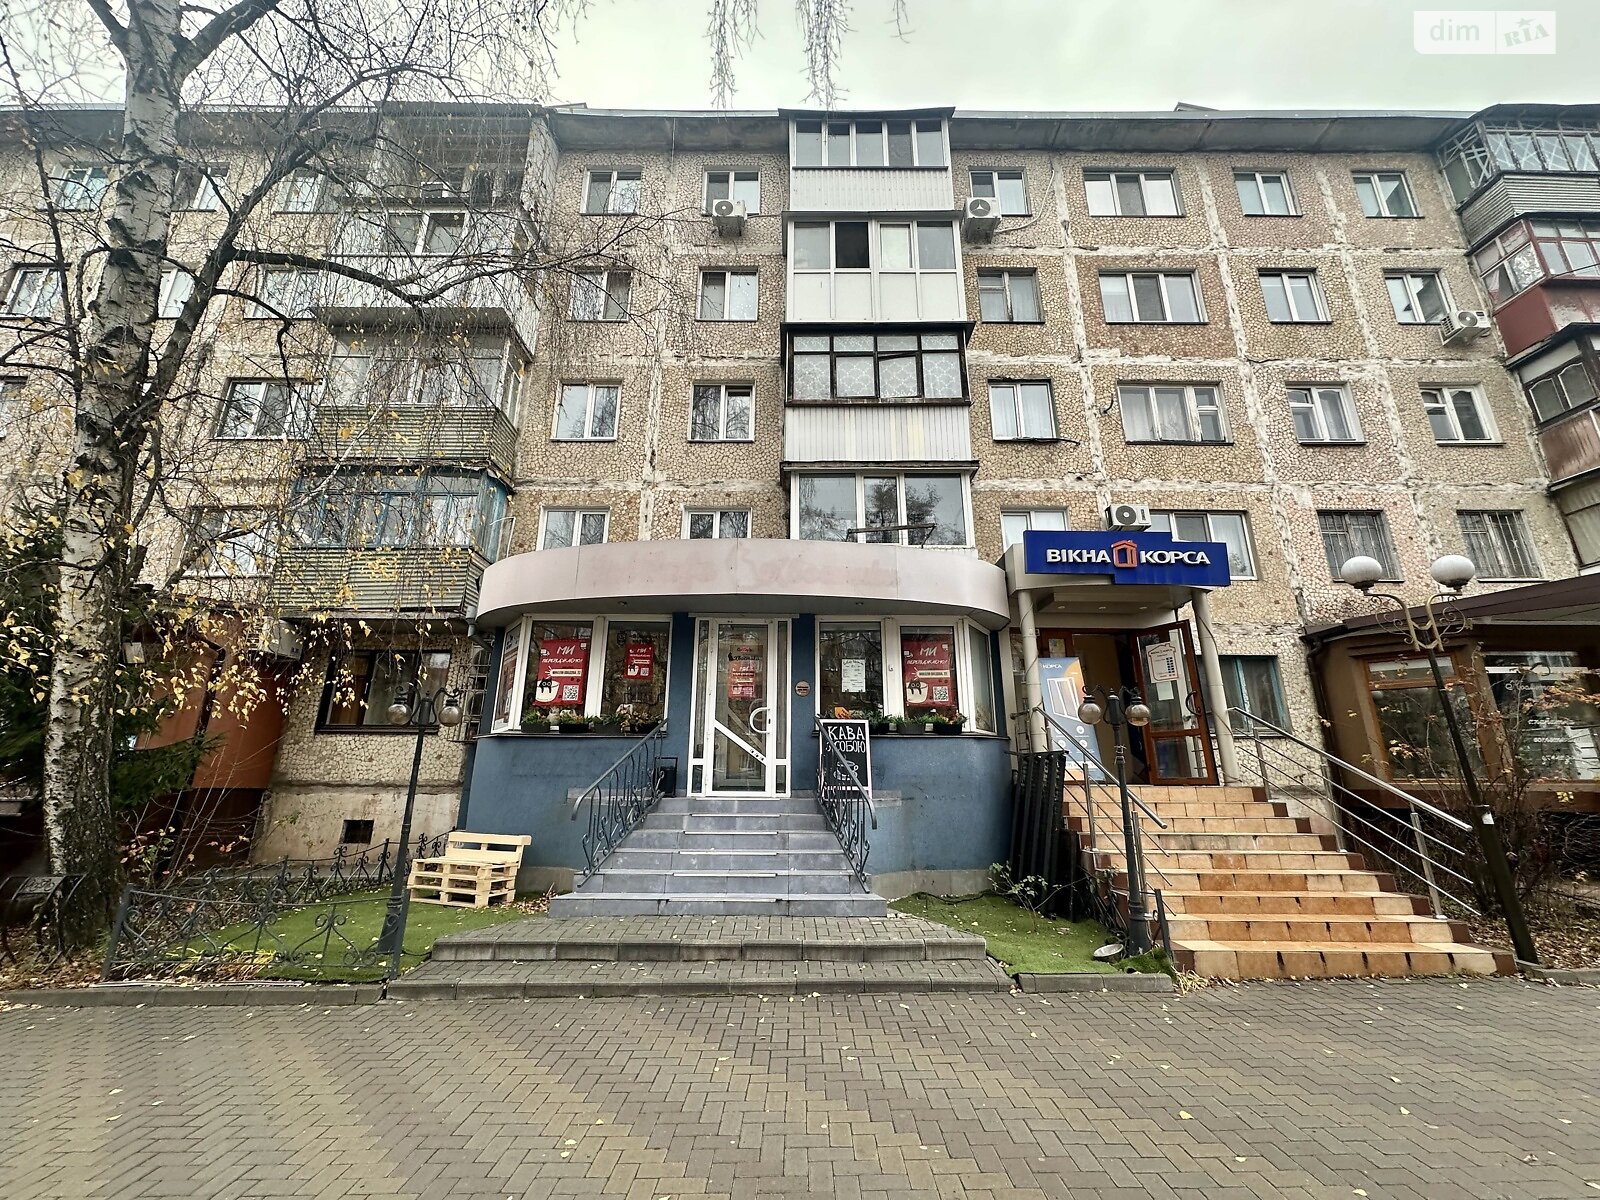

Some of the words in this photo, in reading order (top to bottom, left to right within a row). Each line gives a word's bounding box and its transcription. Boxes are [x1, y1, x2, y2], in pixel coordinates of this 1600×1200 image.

[1046, 549, 1111, 563] ВІКНА
[1140, 550, 1211, 565] КОРСА
[556, 645, 576, 656] МИ
[919, 646, 938, 657] МИ
[827, 726, 866, 741] КАВА
